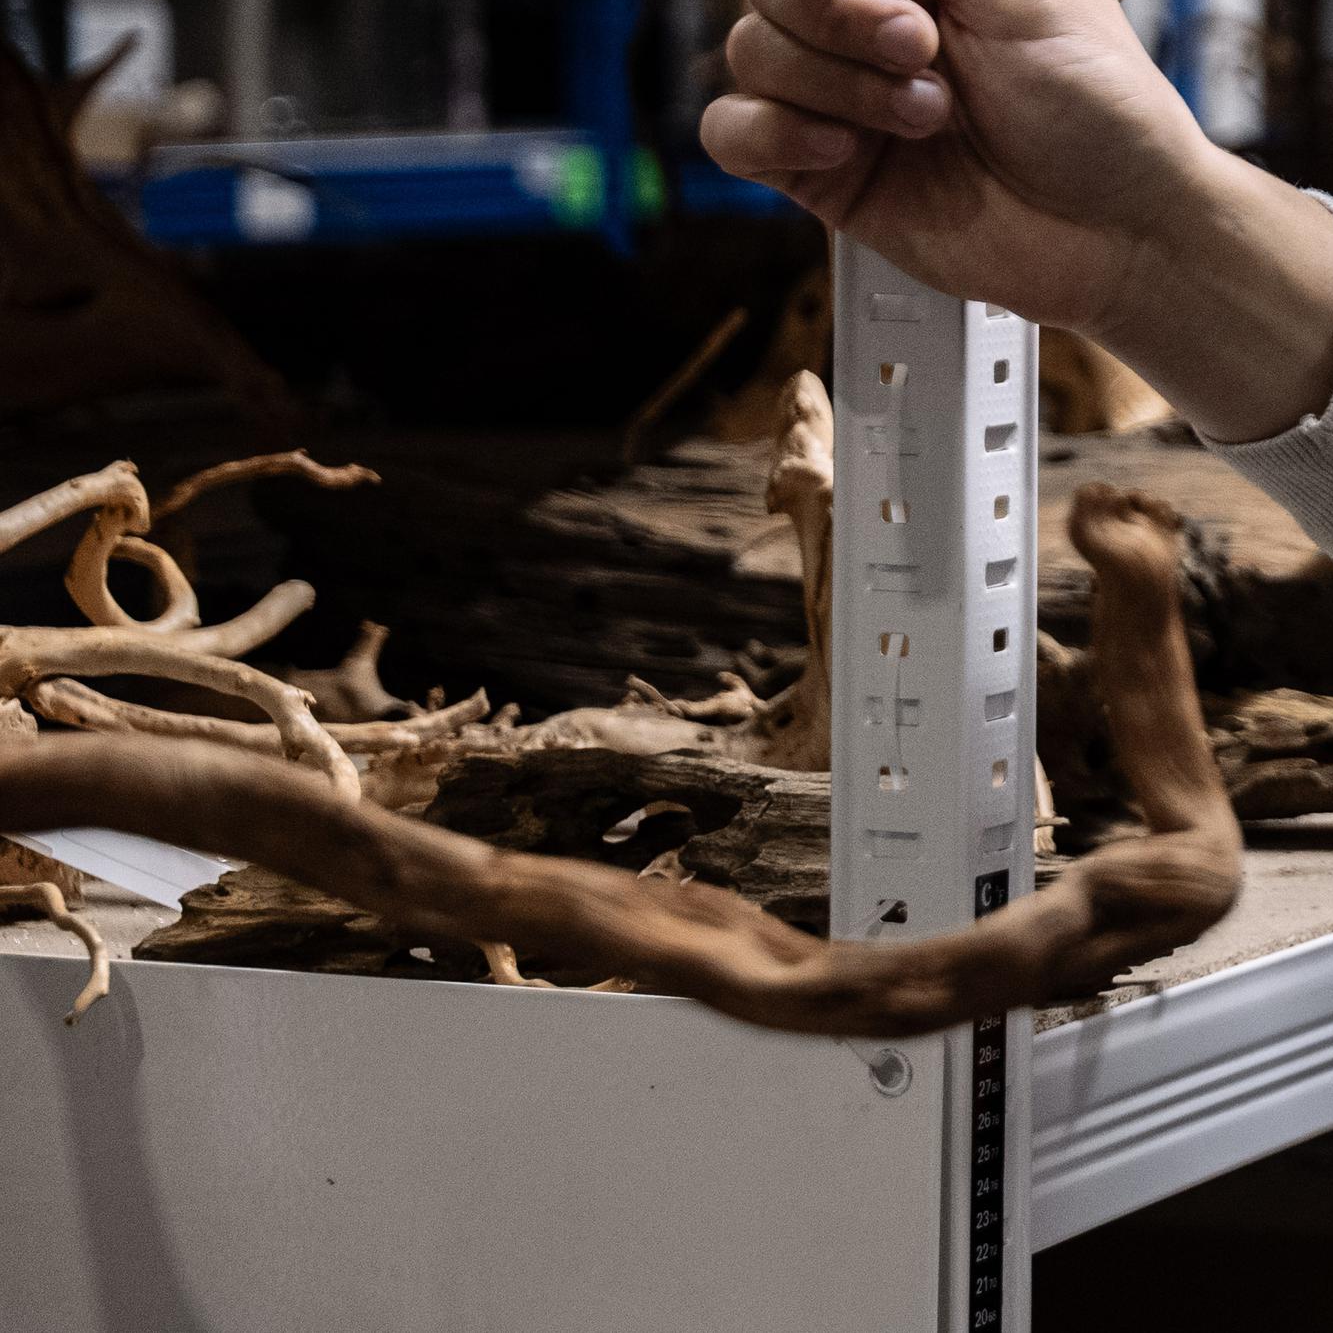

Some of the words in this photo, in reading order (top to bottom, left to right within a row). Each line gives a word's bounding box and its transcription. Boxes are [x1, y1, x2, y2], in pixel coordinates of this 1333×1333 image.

[979, 1046, 992, 1064] 28
[979, 1078, 992, 1098] 27
[978, 1111, 991, 1130] 26
[978, 1144, 991, 1163] 25
[977, 1177, 990, 1196] 24
[976, 1210, 990, 1229] 23
[976, 1242, 989, 1262] 22
[976, 1275, 988, 1295] 21
[975, 1308, 988, 1328] 20
